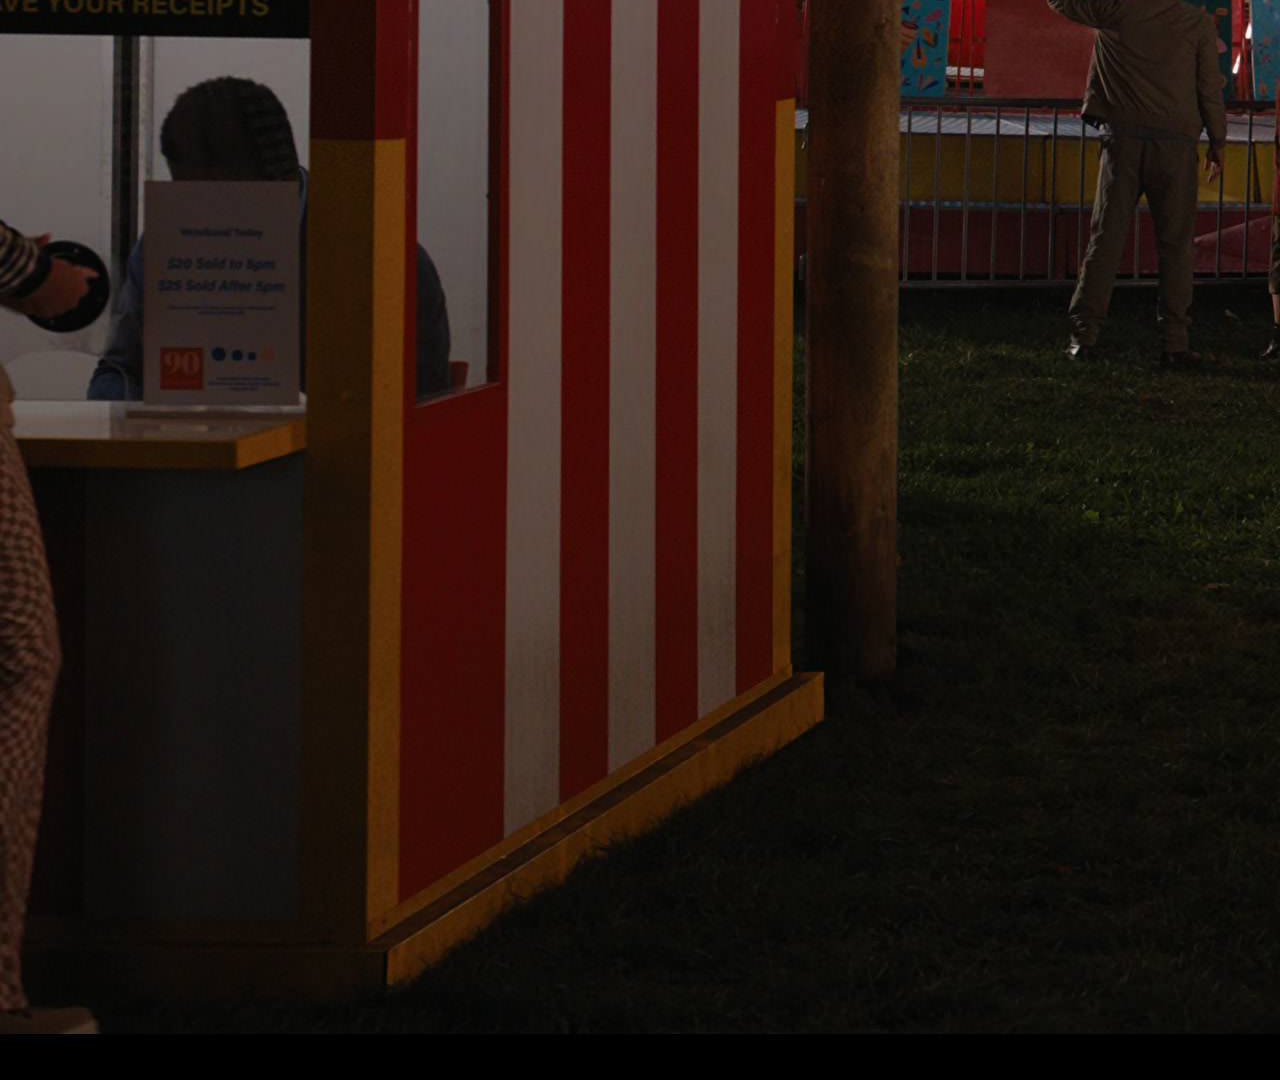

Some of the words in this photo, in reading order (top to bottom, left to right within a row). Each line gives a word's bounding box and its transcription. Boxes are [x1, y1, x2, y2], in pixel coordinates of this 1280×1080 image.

[196, 257, 225, 270] Sold
[185, 279, 216, 292] Sold
[218, 279, 252, 292] After
[163, 351, 200, 376] 90
